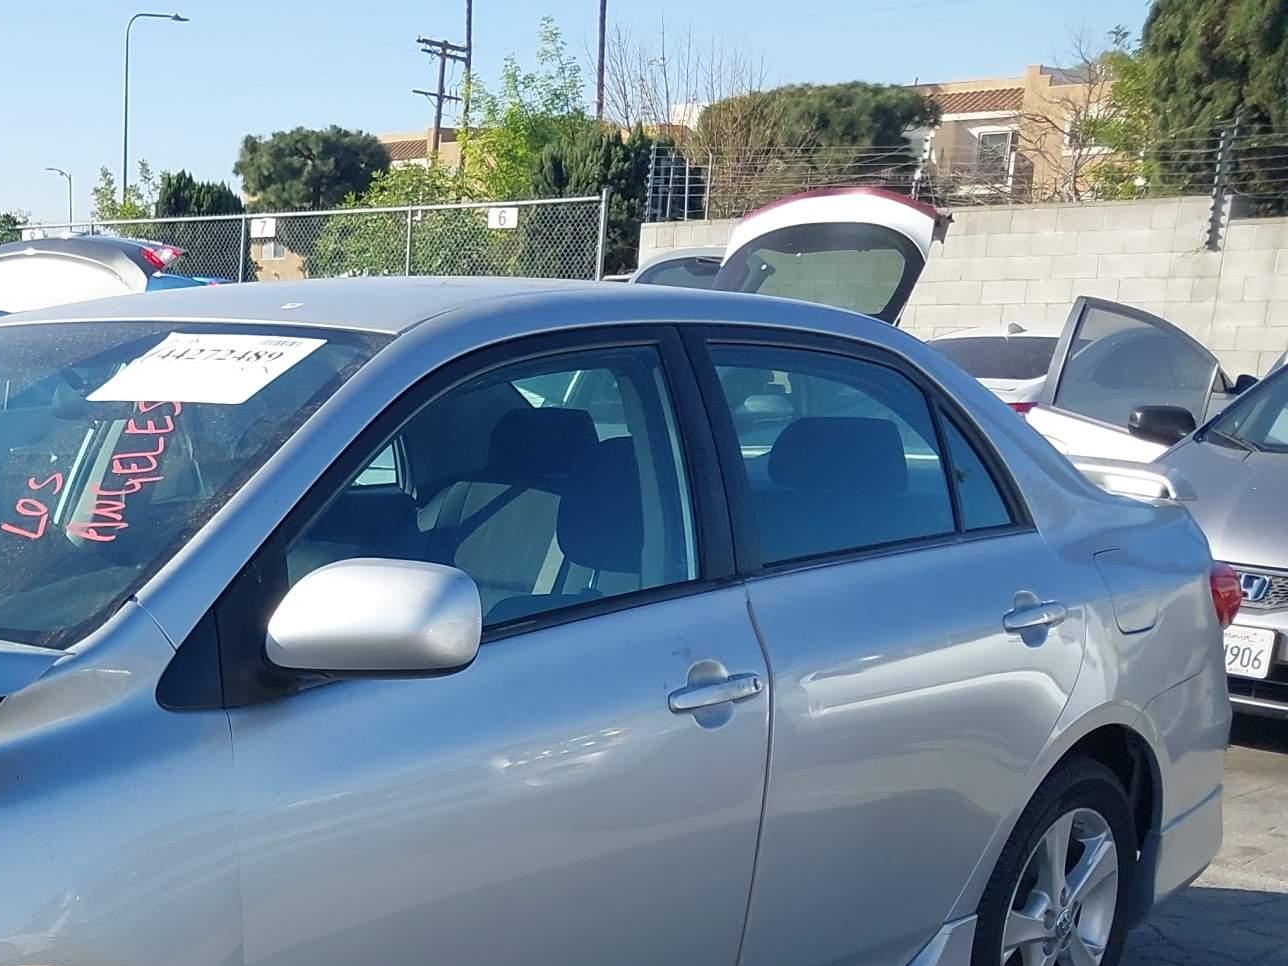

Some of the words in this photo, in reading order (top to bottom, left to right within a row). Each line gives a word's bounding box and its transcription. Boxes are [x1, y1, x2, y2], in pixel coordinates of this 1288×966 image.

[260, 219, 268, 237] 7
[498, 209, 508, 227] 6
[65, 400, 182, 542] ANGELES
[0, 471, 63, 540] LOS
